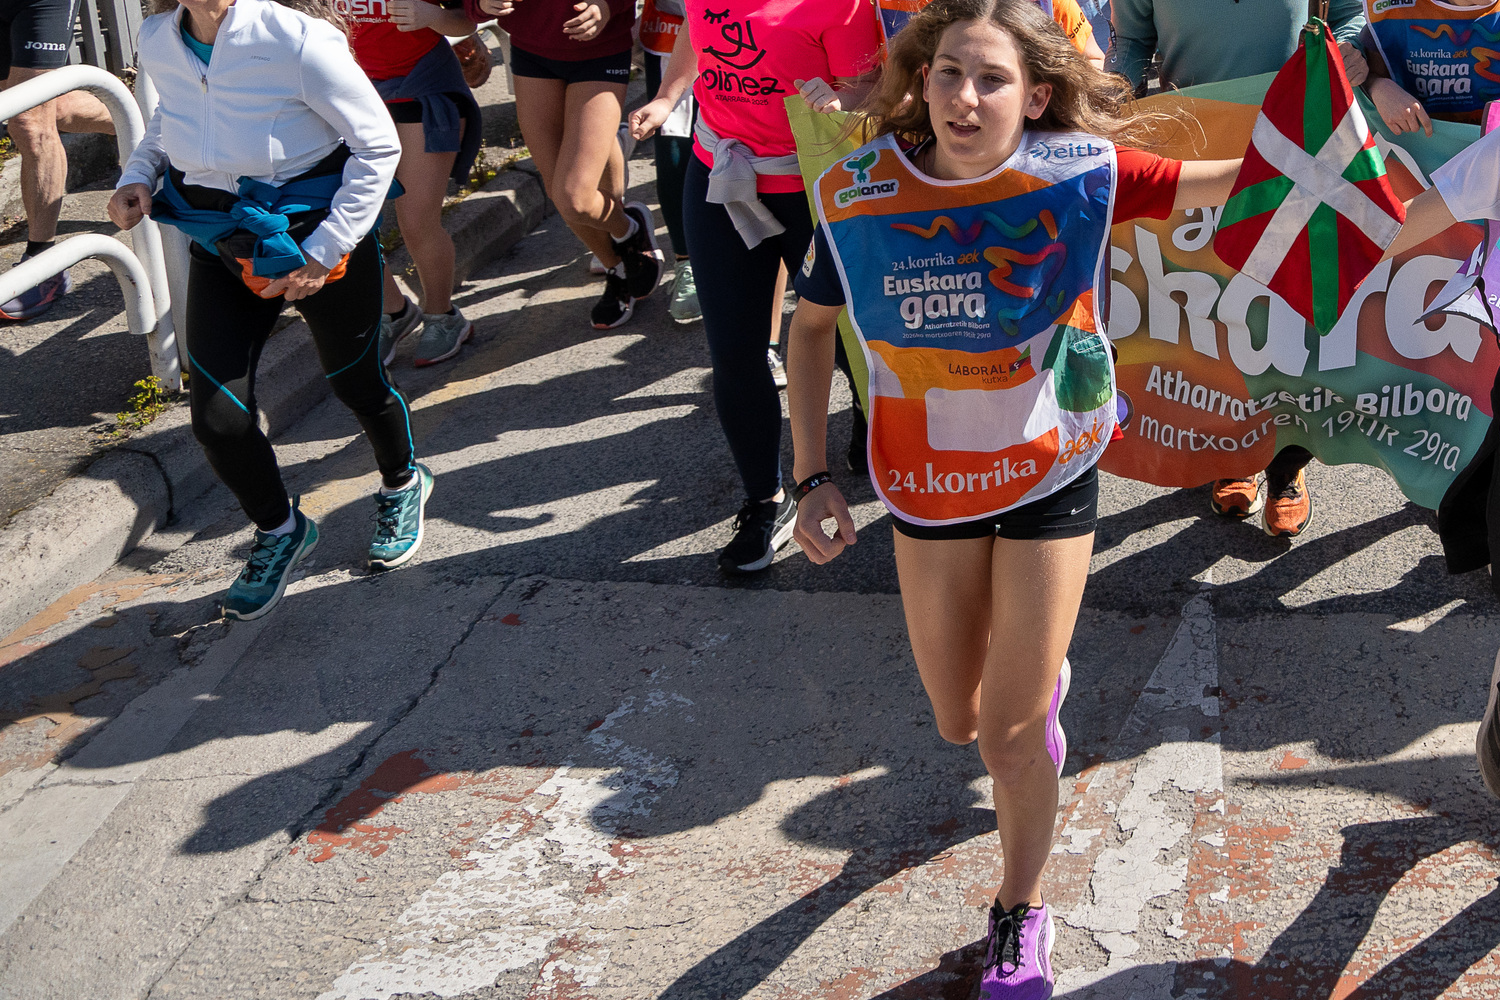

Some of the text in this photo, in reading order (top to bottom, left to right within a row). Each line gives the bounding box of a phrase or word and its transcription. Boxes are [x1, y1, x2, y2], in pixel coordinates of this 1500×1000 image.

[1409, 48, 1469, 60] 24.korrika aek
[1406, 59, 1470, 77] Euskara
[701, 65, 786, 96] oinez
[1415, 75, 1472, 98] gara
[1053, 142, 1102, 160] eitb
[838, 180, 896, 204] goiener
[892, 249, 980, 271] 24.korrika aek
[883, 271, 983, 297] Euskara
[899, 289, 986, 329] gara
[924, 320, 990, 331] Atharratzetik Bilbora
[925, 330, 962, 339] martxoaren
[977, 330, 991, 339] 29ra
[948, 363, 1006, 377] LABORAL
[981, 374, 1008, 384] kutxa
[1145, 365, 1473, 422] Atharratzetik Bilbora
[1139, 410, 1310, 452] martxoaren
[1402, 430, 1462, 473] 29ra
[888, 417, 1103, 495] 24.korrika aek
